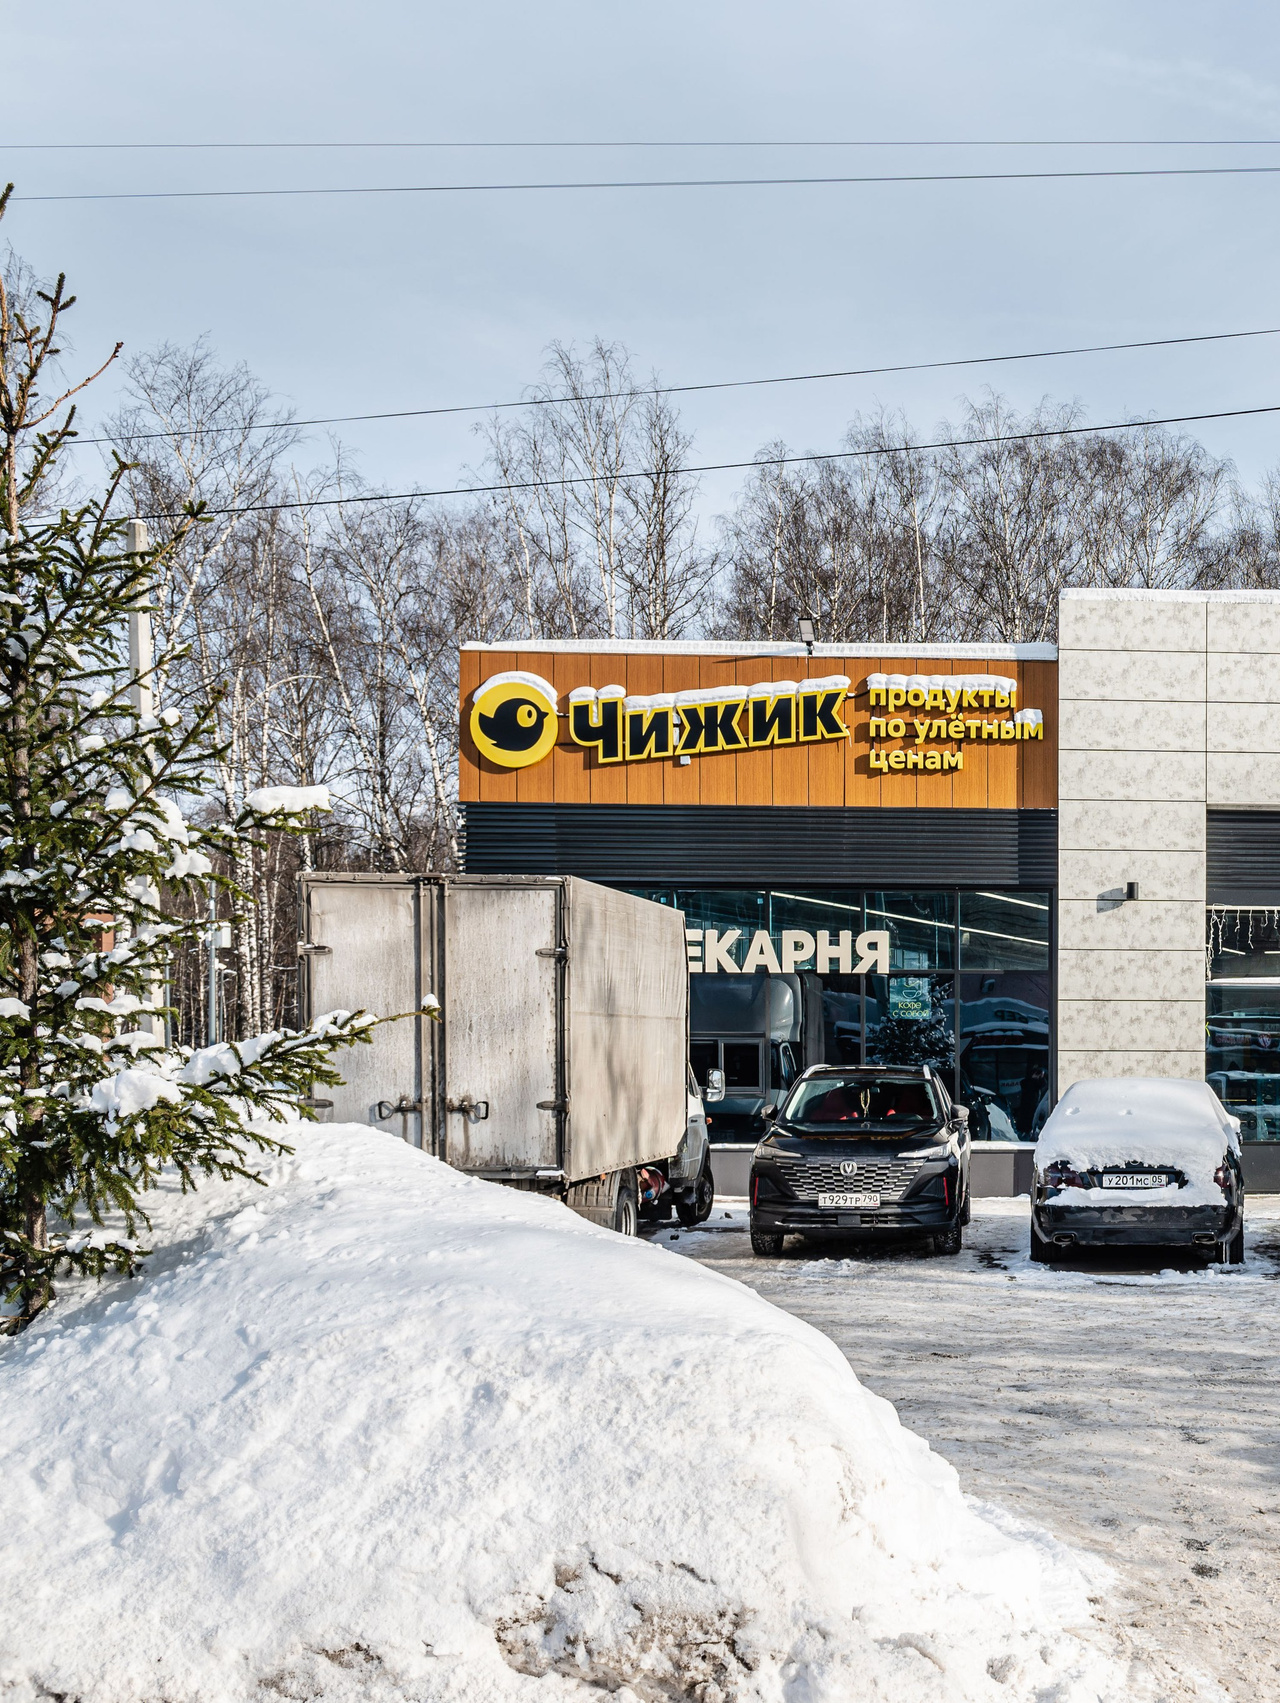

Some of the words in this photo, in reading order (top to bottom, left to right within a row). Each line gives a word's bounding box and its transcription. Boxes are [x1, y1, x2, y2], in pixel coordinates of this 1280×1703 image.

[869, 687, 1017, 713] продукты
[869, 718, 906, 738] по
[914, 712, 1044, 744] улётным
[869, 749, 964, 773] ценам
[686, 929, 890, 974] ЕКАРНЯ
